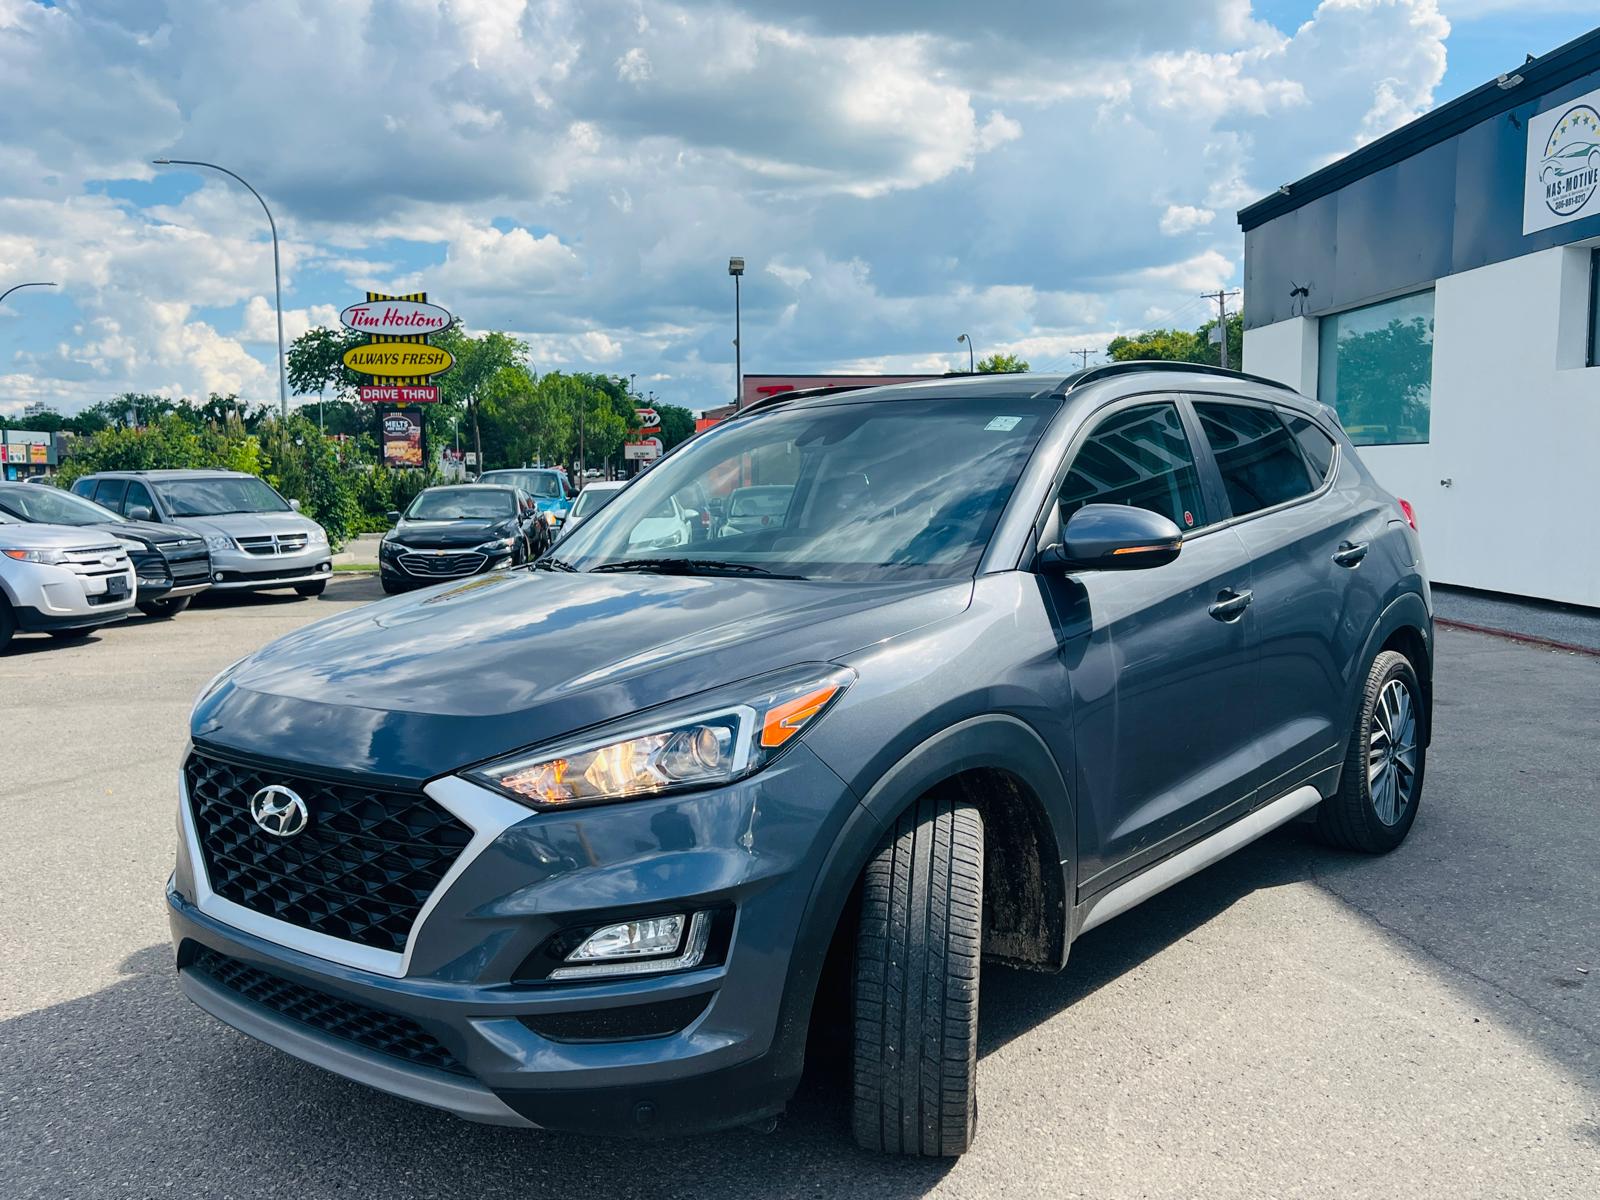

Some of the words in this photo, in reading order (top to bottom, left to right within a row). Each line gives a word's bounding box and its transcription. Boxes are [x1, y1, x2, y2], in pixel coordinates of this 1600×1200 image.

[350, 308, 380, 327] Tim
[382, 308, 443, 327] Hortons
[349, 353, 399, 365] ALWAYS
[402, 353, 445, 364] FRESH
[363, 389, 398, 399] DRIVE
[402, 389, 435, 399] THRU
[385, 420, 409, 428] MELTS
